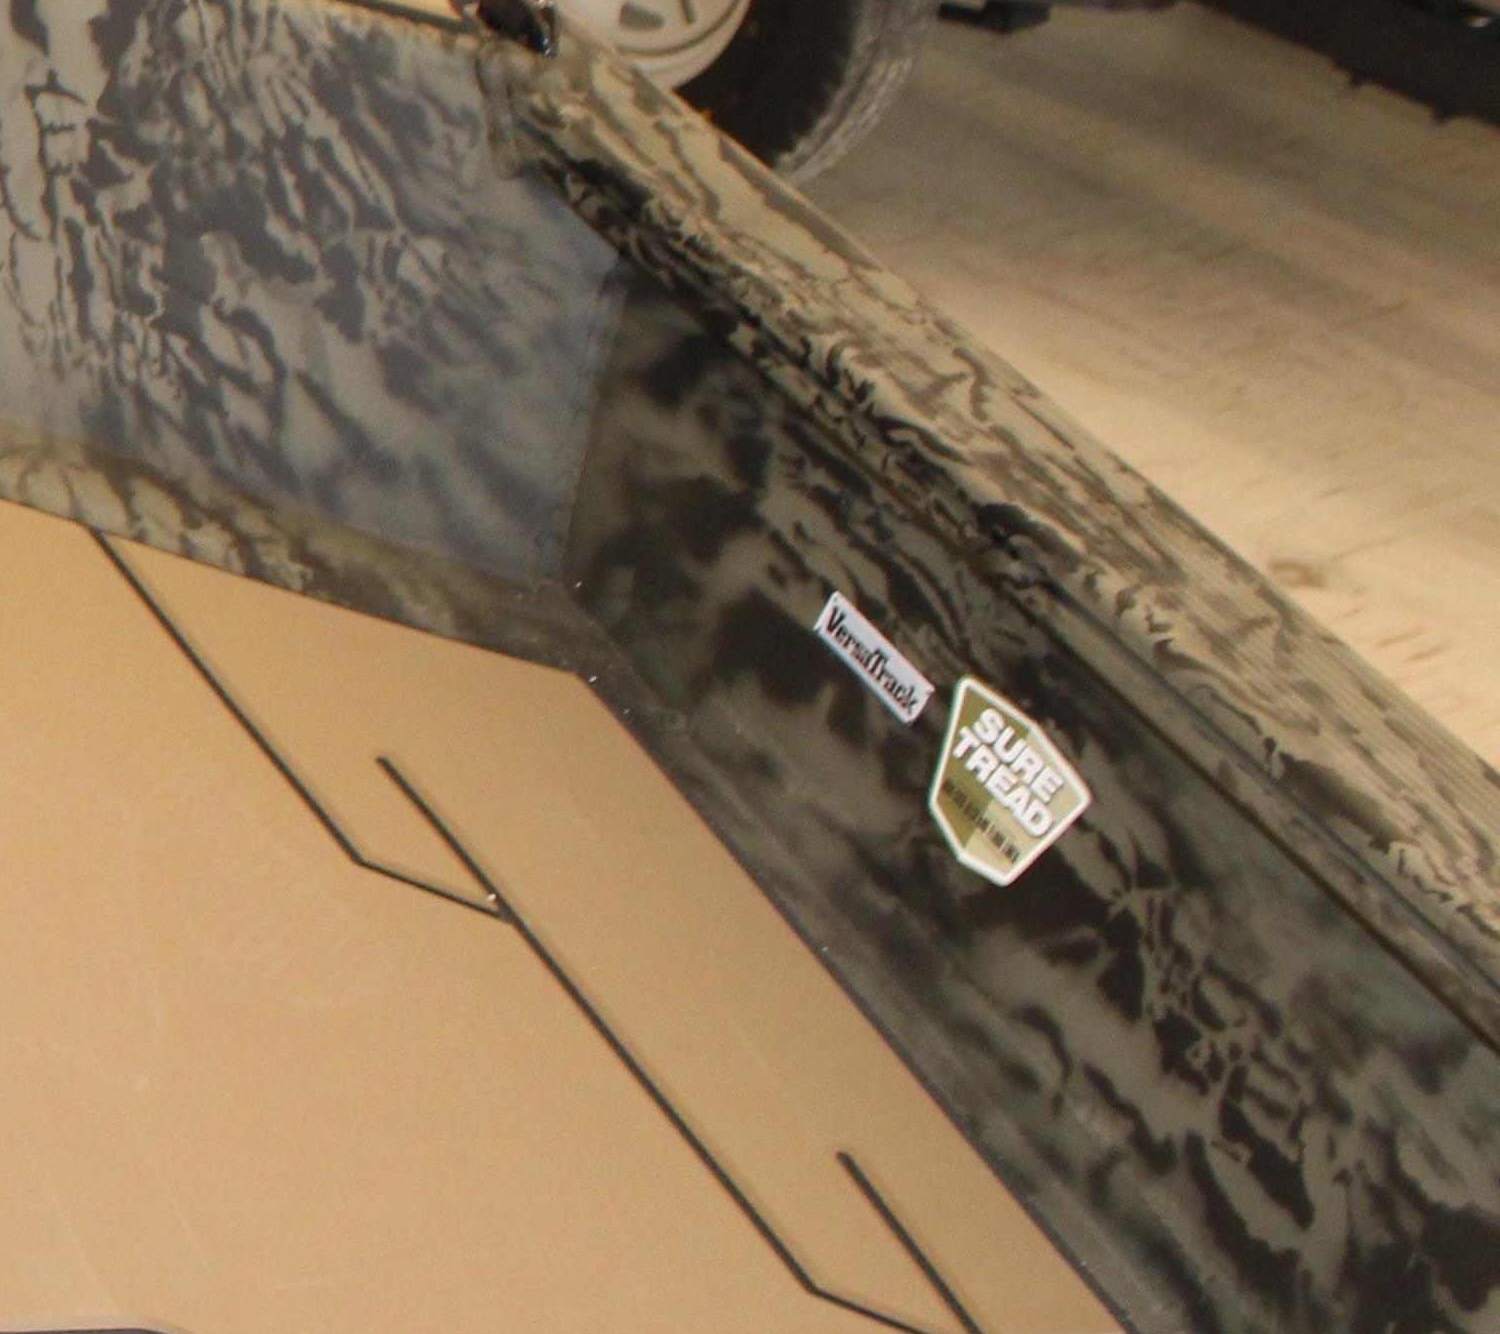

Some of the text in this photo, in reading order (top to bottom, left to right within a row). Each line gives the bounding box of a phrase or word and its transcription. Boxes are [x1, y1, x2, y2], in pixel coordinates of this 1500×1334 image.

[824, 607, 917, 714] VersaTrack
[952, 727, 1054, 836] TREAD
[975, 708, 1064, 804] SURE
